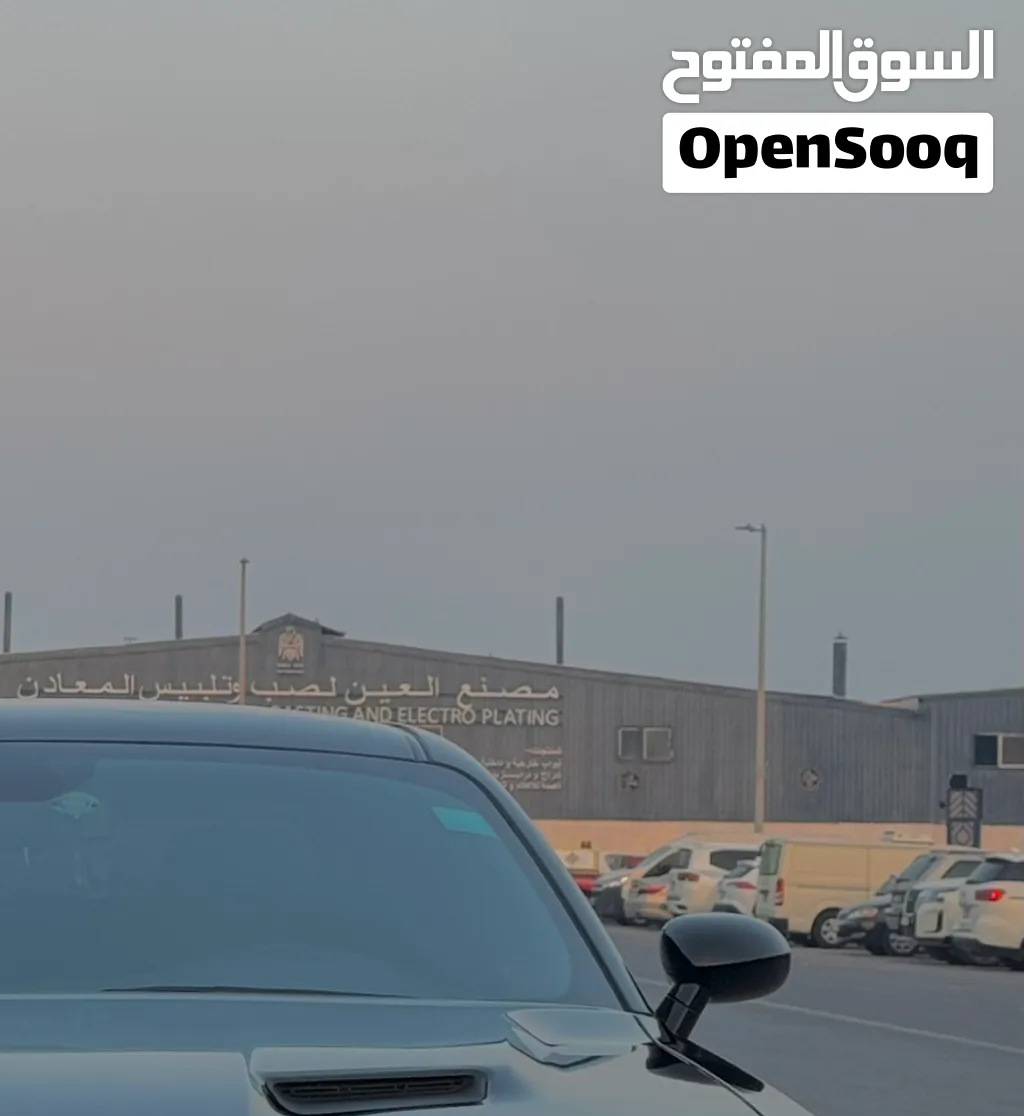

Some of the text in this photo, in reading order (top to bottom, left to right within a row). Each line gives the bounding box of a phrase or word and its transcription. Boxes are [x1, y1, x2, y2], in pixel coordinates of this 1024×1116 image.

[17, 672, 560, 713] مصنع العين لصب وتلبيس المعادن
[271, 704, 560, 726] STING AND ELECTRO PLATING
